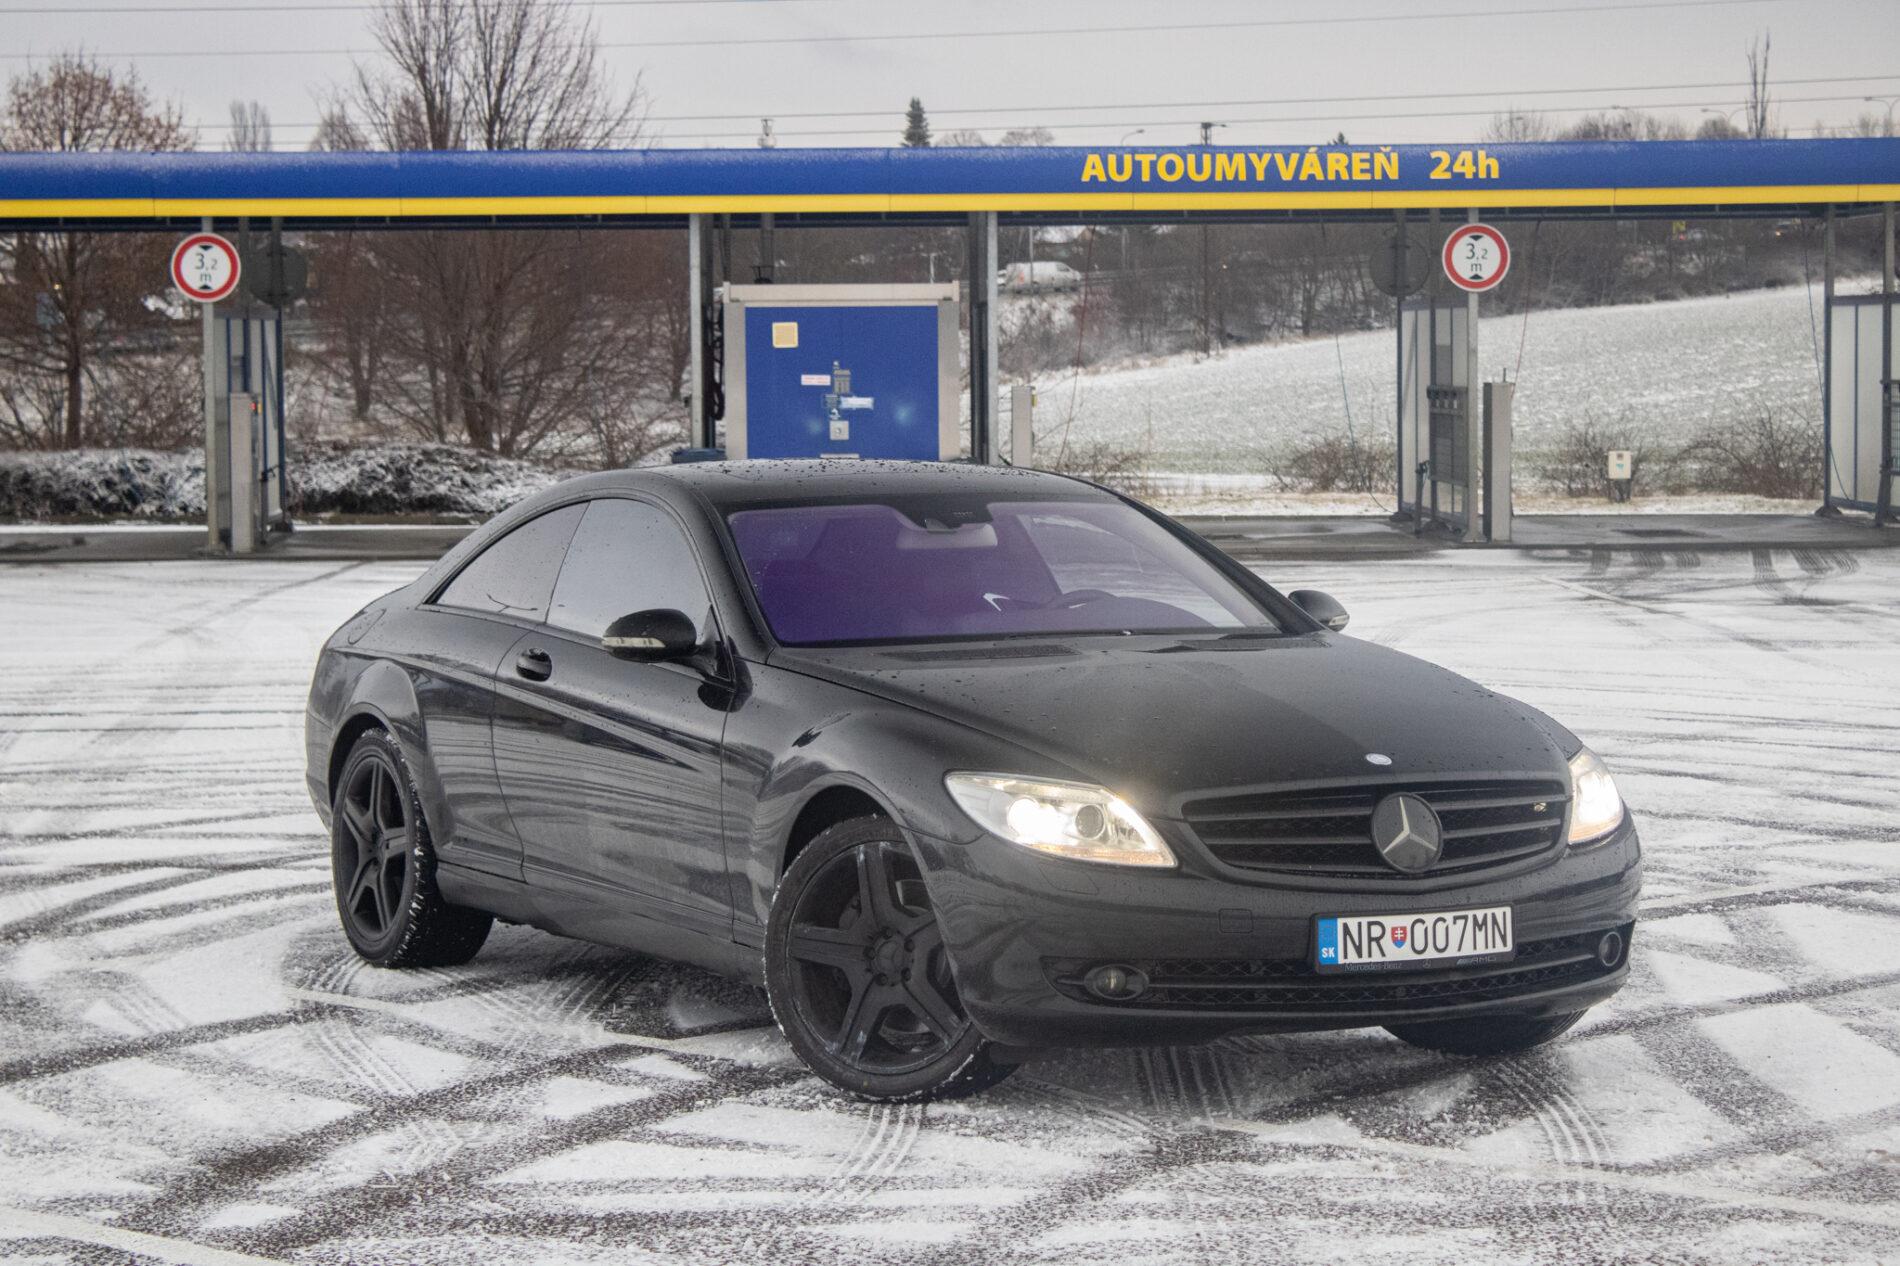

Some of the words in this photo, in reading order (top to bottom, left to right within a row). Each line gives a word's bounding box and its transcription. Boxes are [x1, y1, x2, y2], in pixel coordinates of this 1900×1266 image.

[1081, 147, 1399, 182] AUTOUMYVÁREŇ
[1429, 150, 1500, 180] 24h
[1470, 263, 1482, 272] m
[200, 273, 212, 282] m
[1342, 920, 1386, 960] NR
[1410, 911, 1508, 955] 007MN
[1321, 947, 1335, 958] SK
